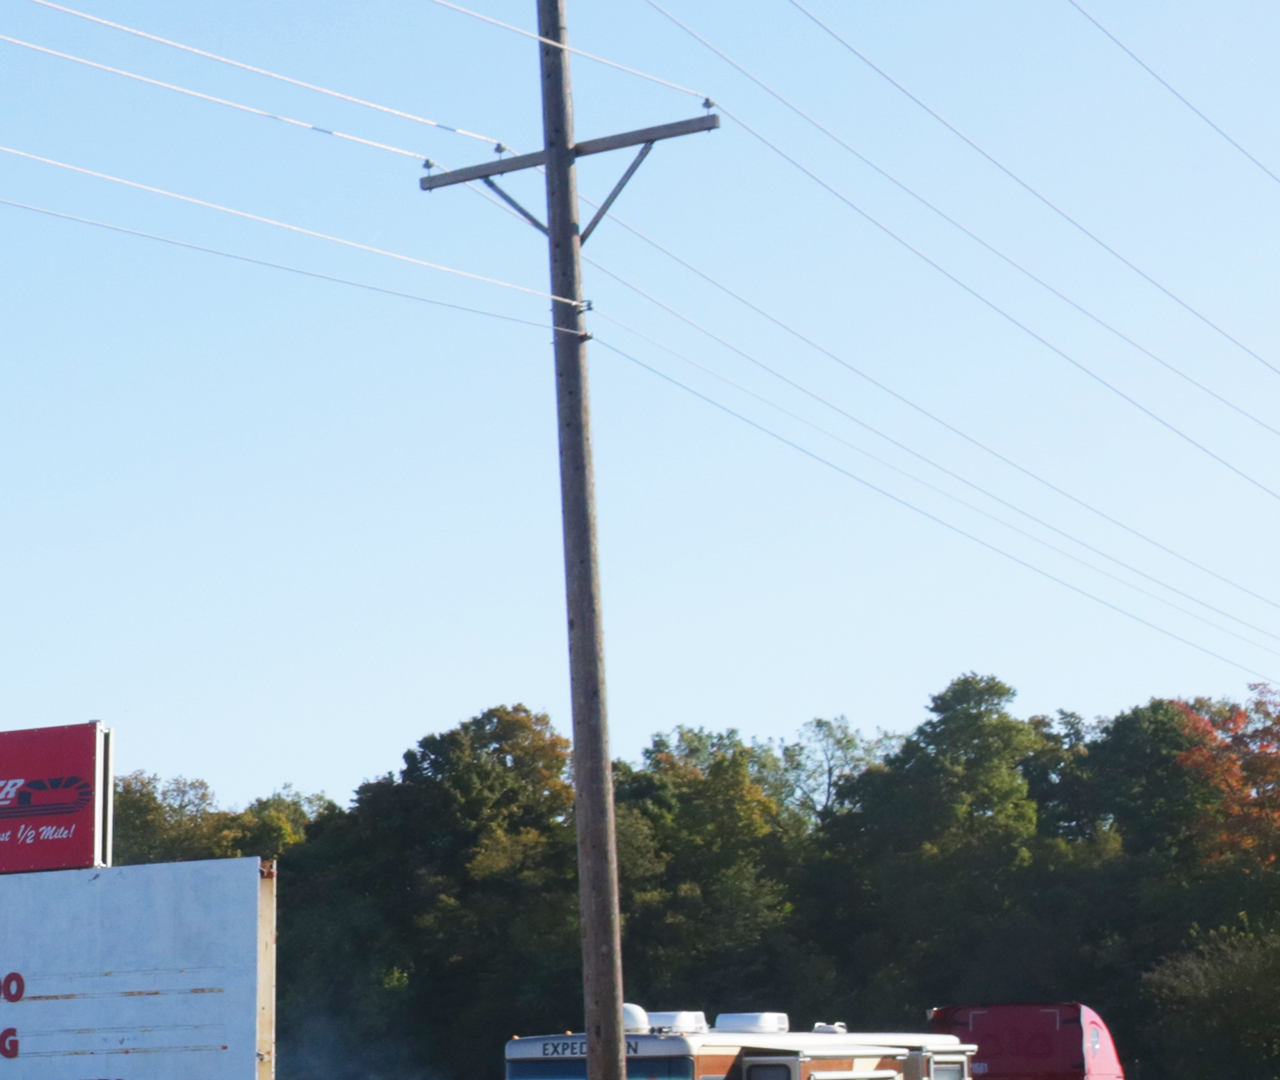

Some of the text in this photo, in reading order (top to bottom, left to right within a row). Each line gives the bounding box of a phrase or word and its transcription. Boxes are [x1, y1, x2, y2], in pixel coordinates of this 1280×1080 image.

[18, 824, 36, 844] 1/2
[39, 824, 76, 840] Mile!
[542, 1041, 639, 1056] EXPEDN
